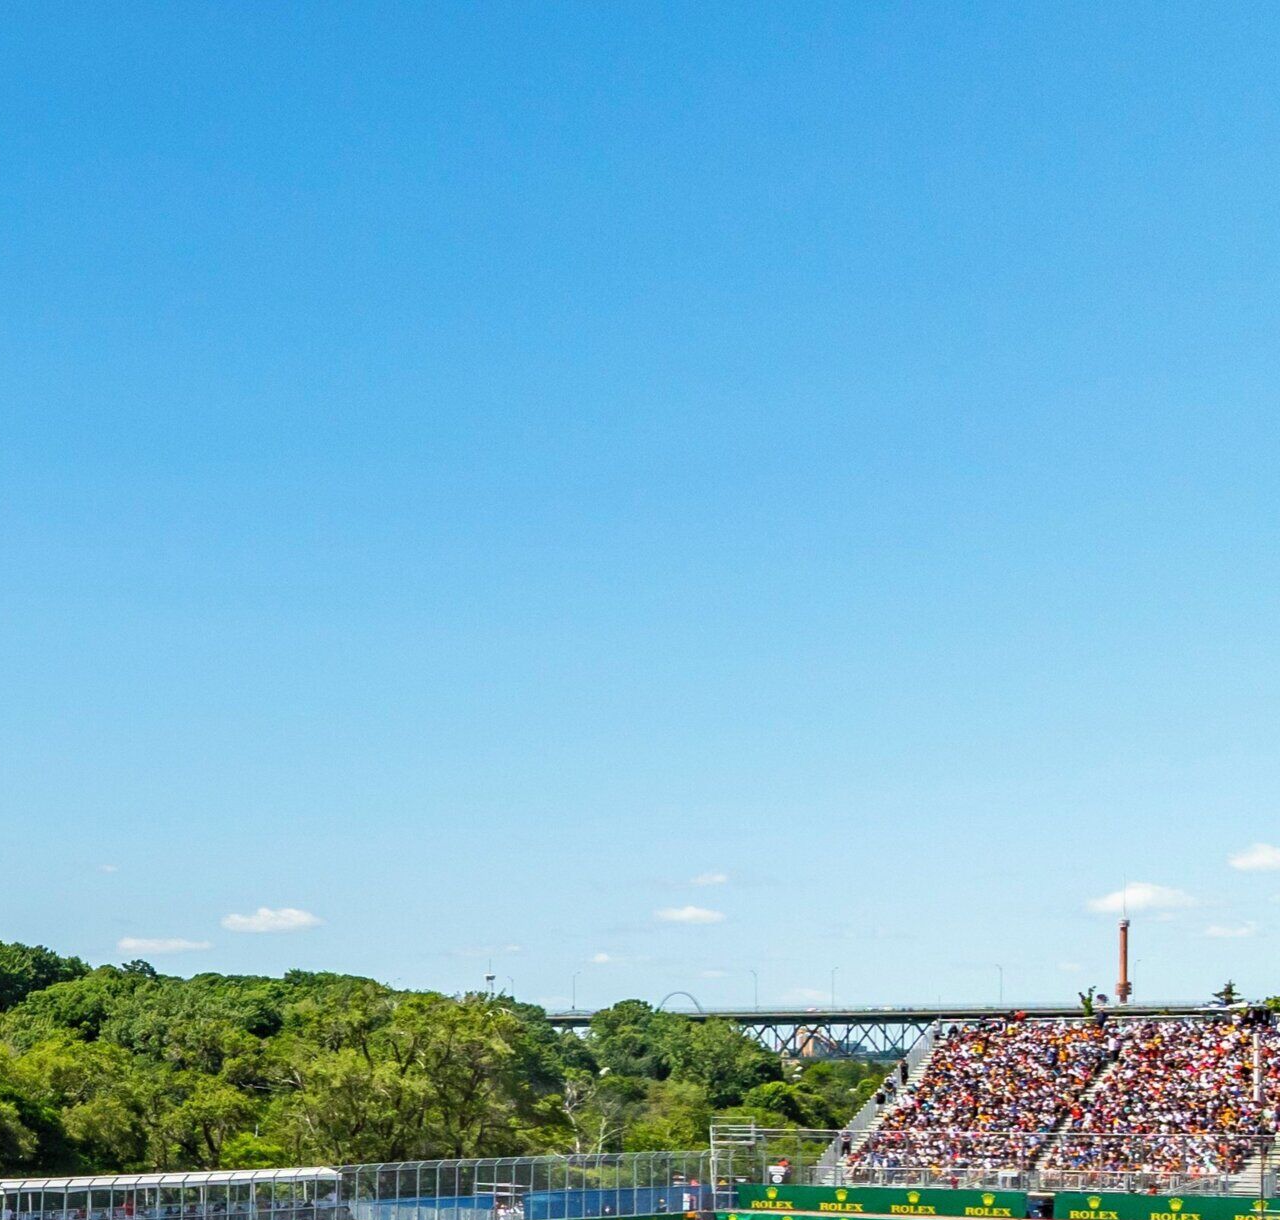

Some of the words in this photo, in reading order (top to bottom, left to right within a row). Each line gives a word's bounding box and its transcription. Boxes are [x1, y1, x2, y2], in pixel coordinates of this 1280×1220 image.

[751, 1201, 793, 1209] ROLEX
[821, 1203, 862, 1212] ROLEX
[891, 1205, 935, 1214] ROLEX
[966, 1208, 1010, 1217] ROLEX
[1070, 1211, 1117, 1219] ROLEX
